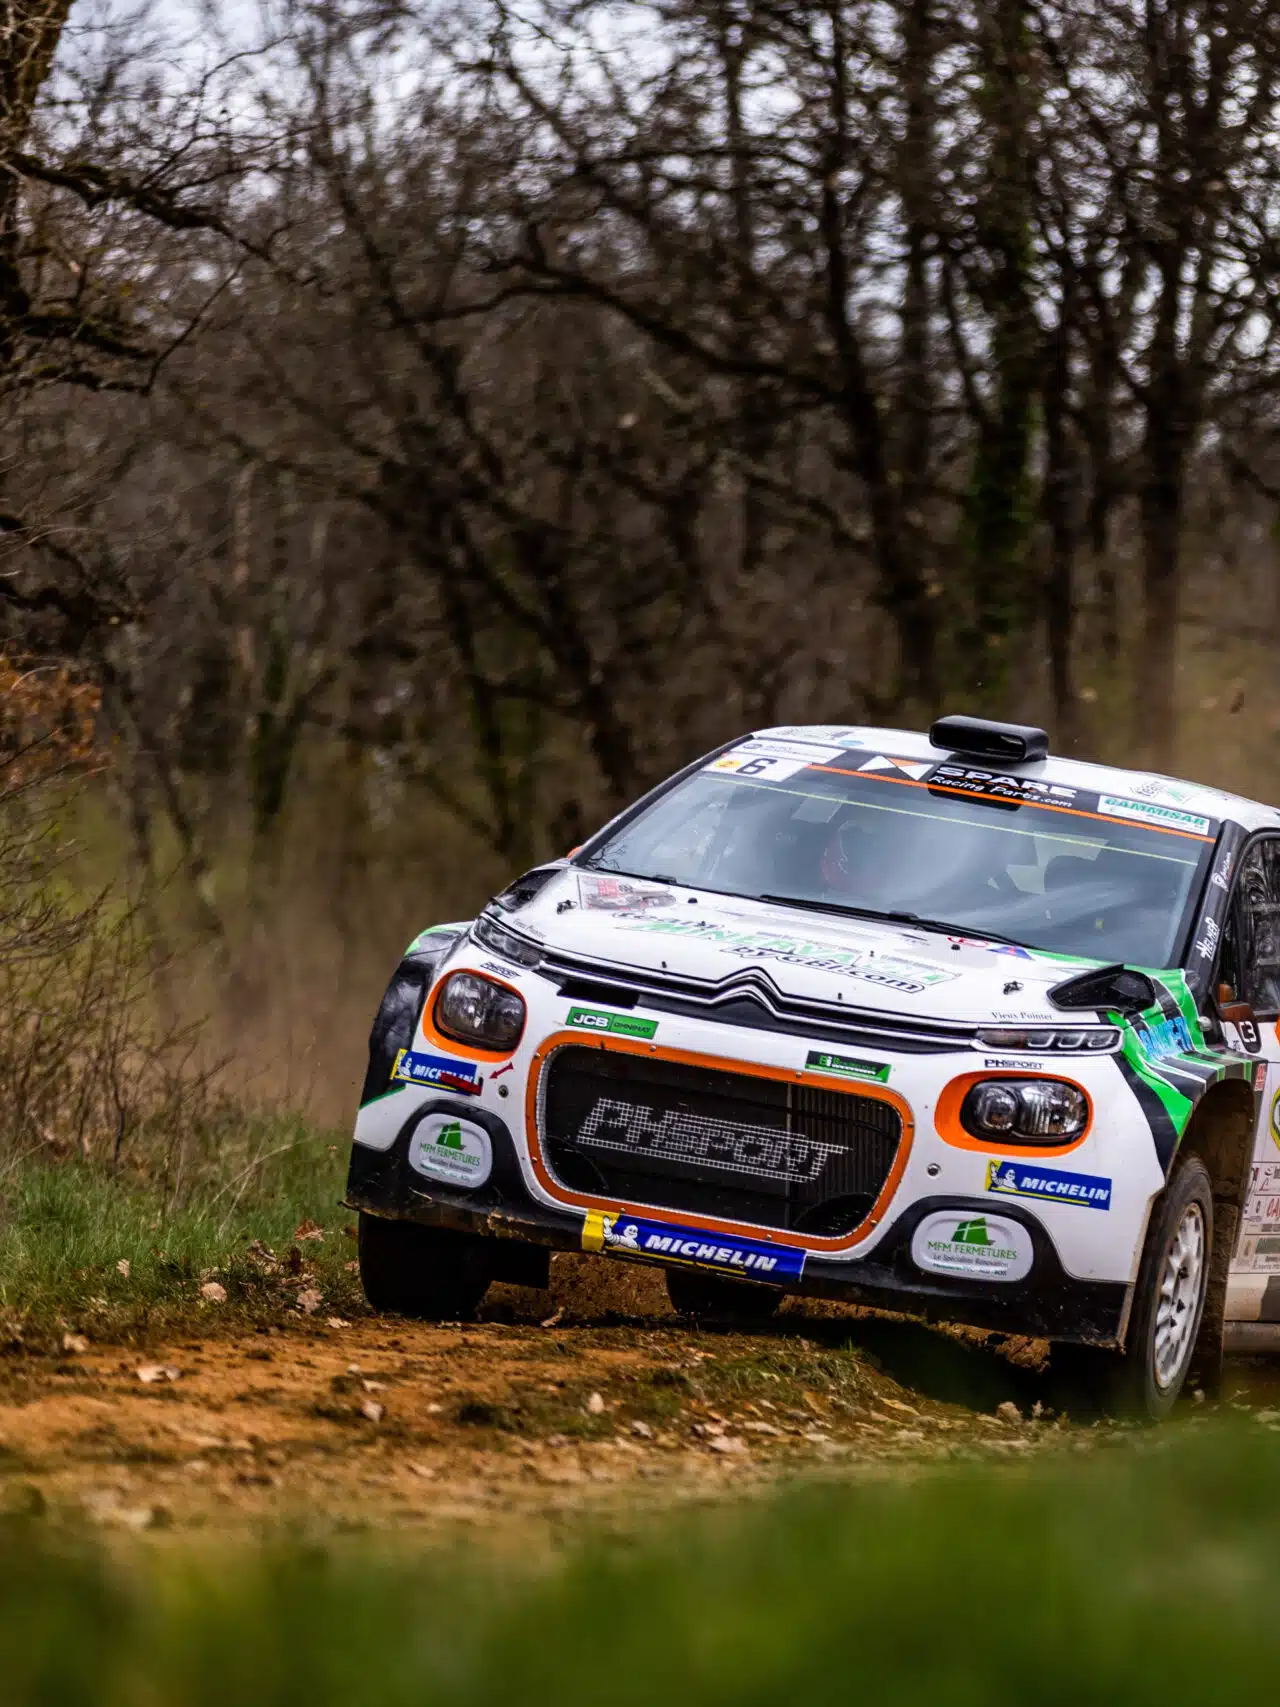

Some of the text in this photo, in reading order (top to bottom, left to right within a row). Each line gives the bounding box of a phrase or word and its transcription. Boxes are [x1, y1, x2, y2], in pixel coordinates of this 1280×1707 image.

[736, 758, 777, 774] 6
[928, 775, 984, 792] Racing
[936, 766, 1077, 799] SPARE
[572, 1013, 609, 1028] JCB
[1239, 1021, 1258, 1043] C3
[984, 1058, 1045, 1069] PHSPORT
[578, 1098, 853, 1176] PHSPORT
[1020, 1177, 1110, 1201] MICHELIN
[645, 1234, 778, 1271] MICHELIN
[927, 1241, 1018, 1261] MFM FERMETURES
